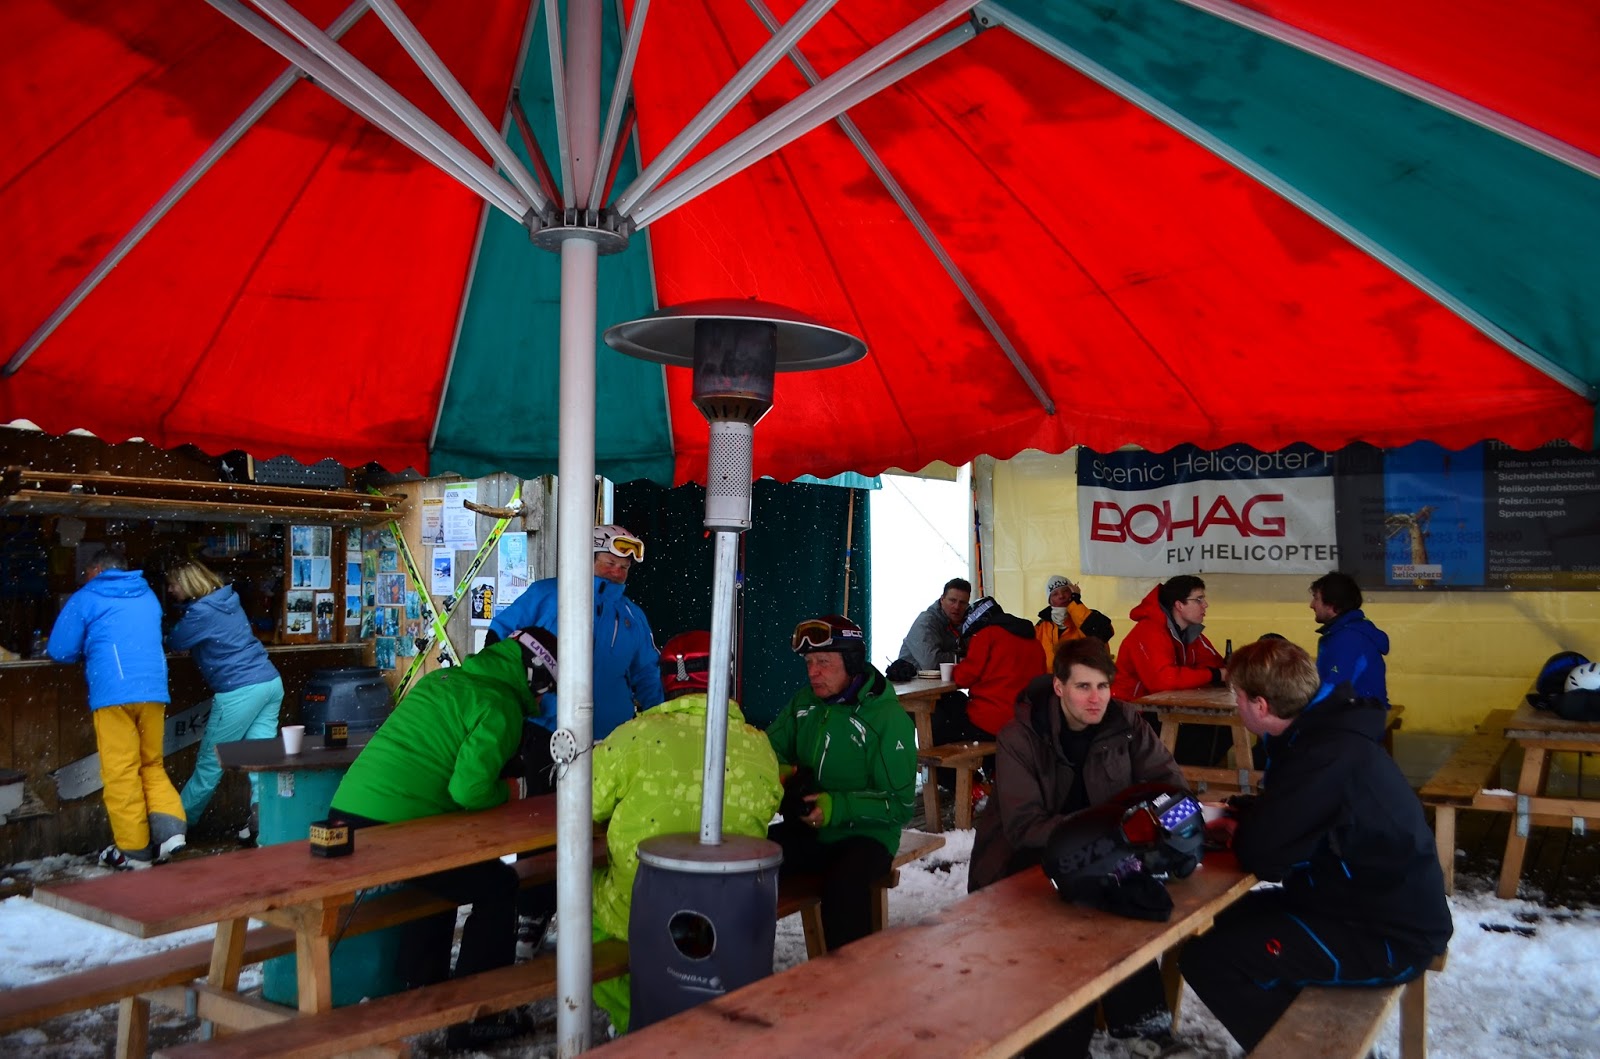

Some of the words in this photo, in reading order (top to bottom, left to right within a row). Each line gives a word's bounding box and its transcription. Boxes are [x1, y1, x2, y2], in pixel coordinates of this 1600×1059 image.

[1092, 459, 1166, 484] Scenic
[1173, 450, 1315, 476] Helicopter
[1498, 470, 1595, 481] Sicherheitsholzerei
[1498, 497, 1565, 506] Felsräumung
[1090, 493, 1286, 545] BOHAG
[1498, 509, 1567, 518] Sprengungen
[1166, 545, 1195, 564] FLY
[1201, 544, 1343, 562] HELICOPTER
[1392, 571, 1436, 579] helicopter
